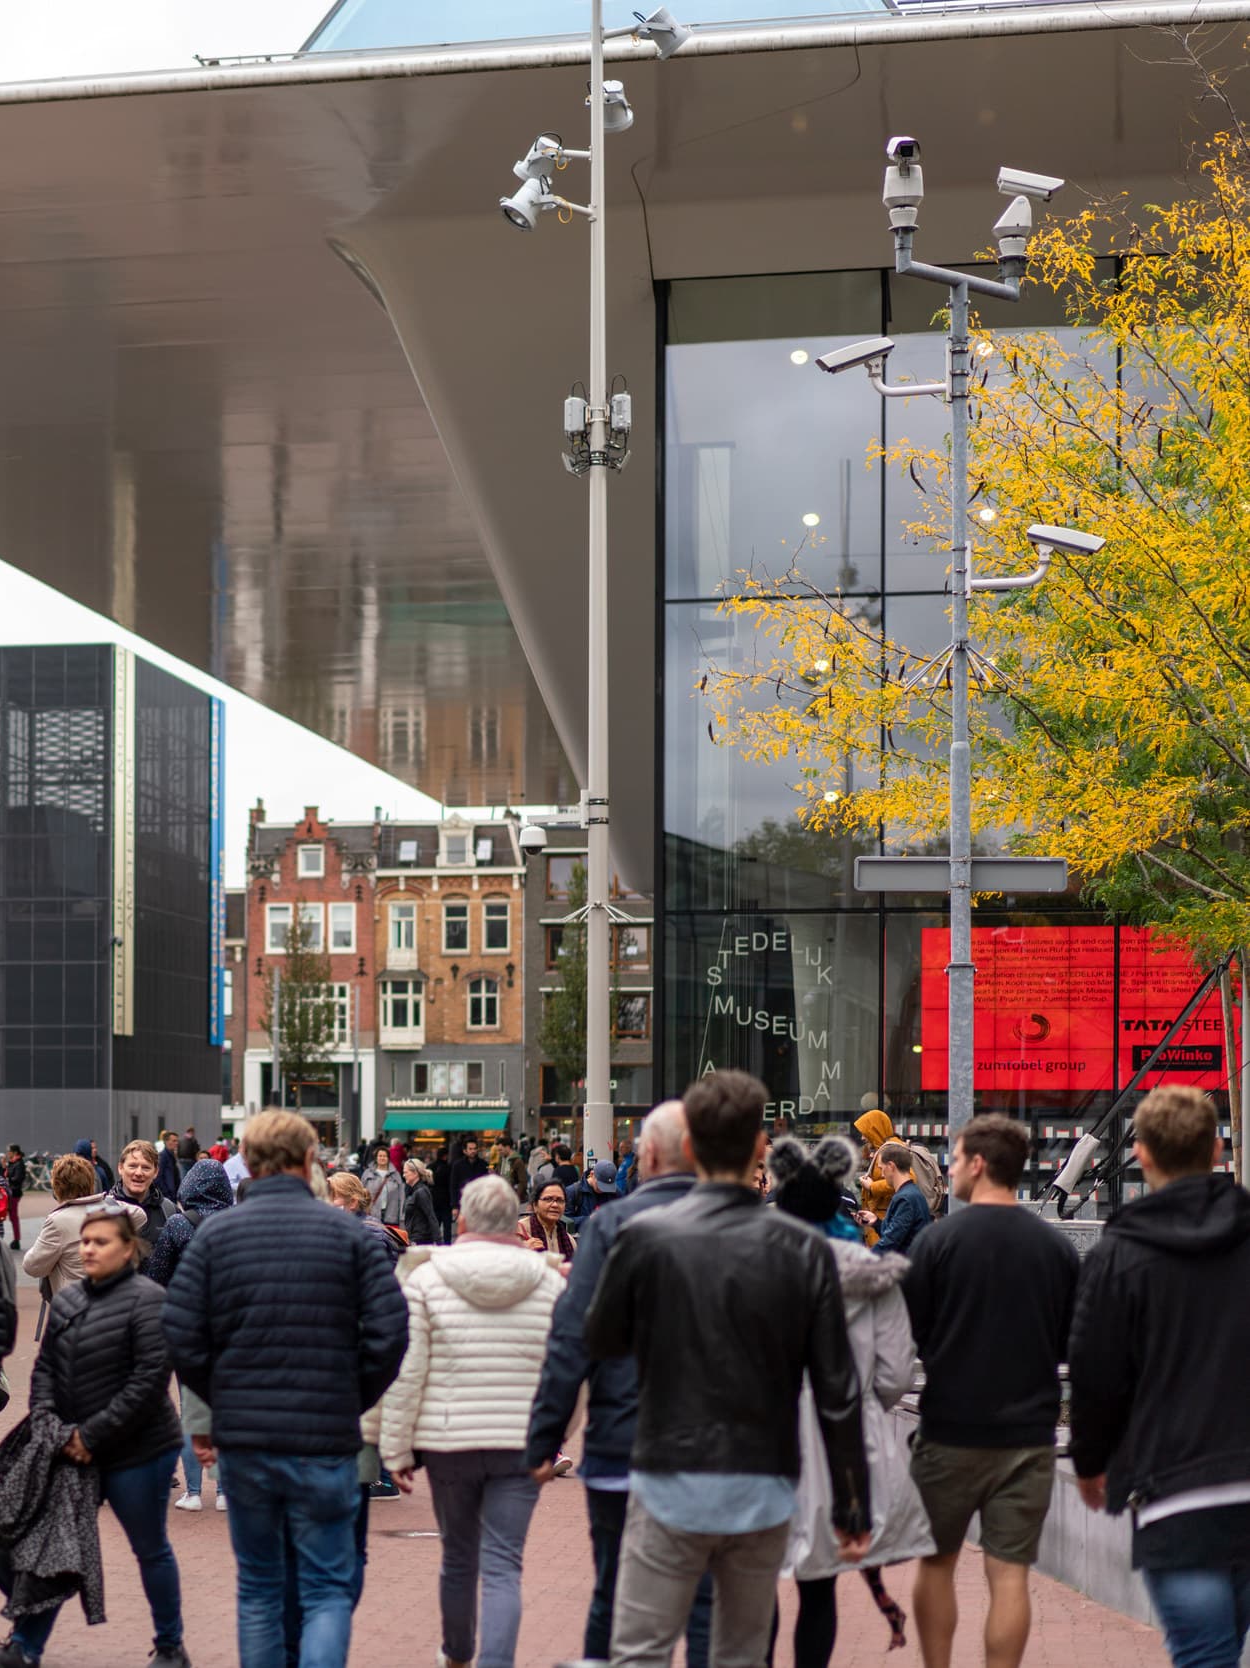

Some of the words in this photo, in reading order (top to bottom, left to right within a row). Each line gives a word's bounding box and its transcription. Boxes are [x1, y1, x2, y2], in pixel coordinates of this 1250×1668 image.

[707, 932, 832, 985] STEDELIJK
[715, 995, 827, 1049] MUSEUM
[1122, 1019, 1178, 1031] TATA
[1181, 1019, 1223, 1031] STEE
[977, 1059, 1043, 1071] zumtobel
[1045, 1061, 1087, 1073] group
[385, 1097, 437, 1107] bookhandel
[438, 1097, 467, 1107] robert
[702, 1060, 841, 1121] AERDAM
